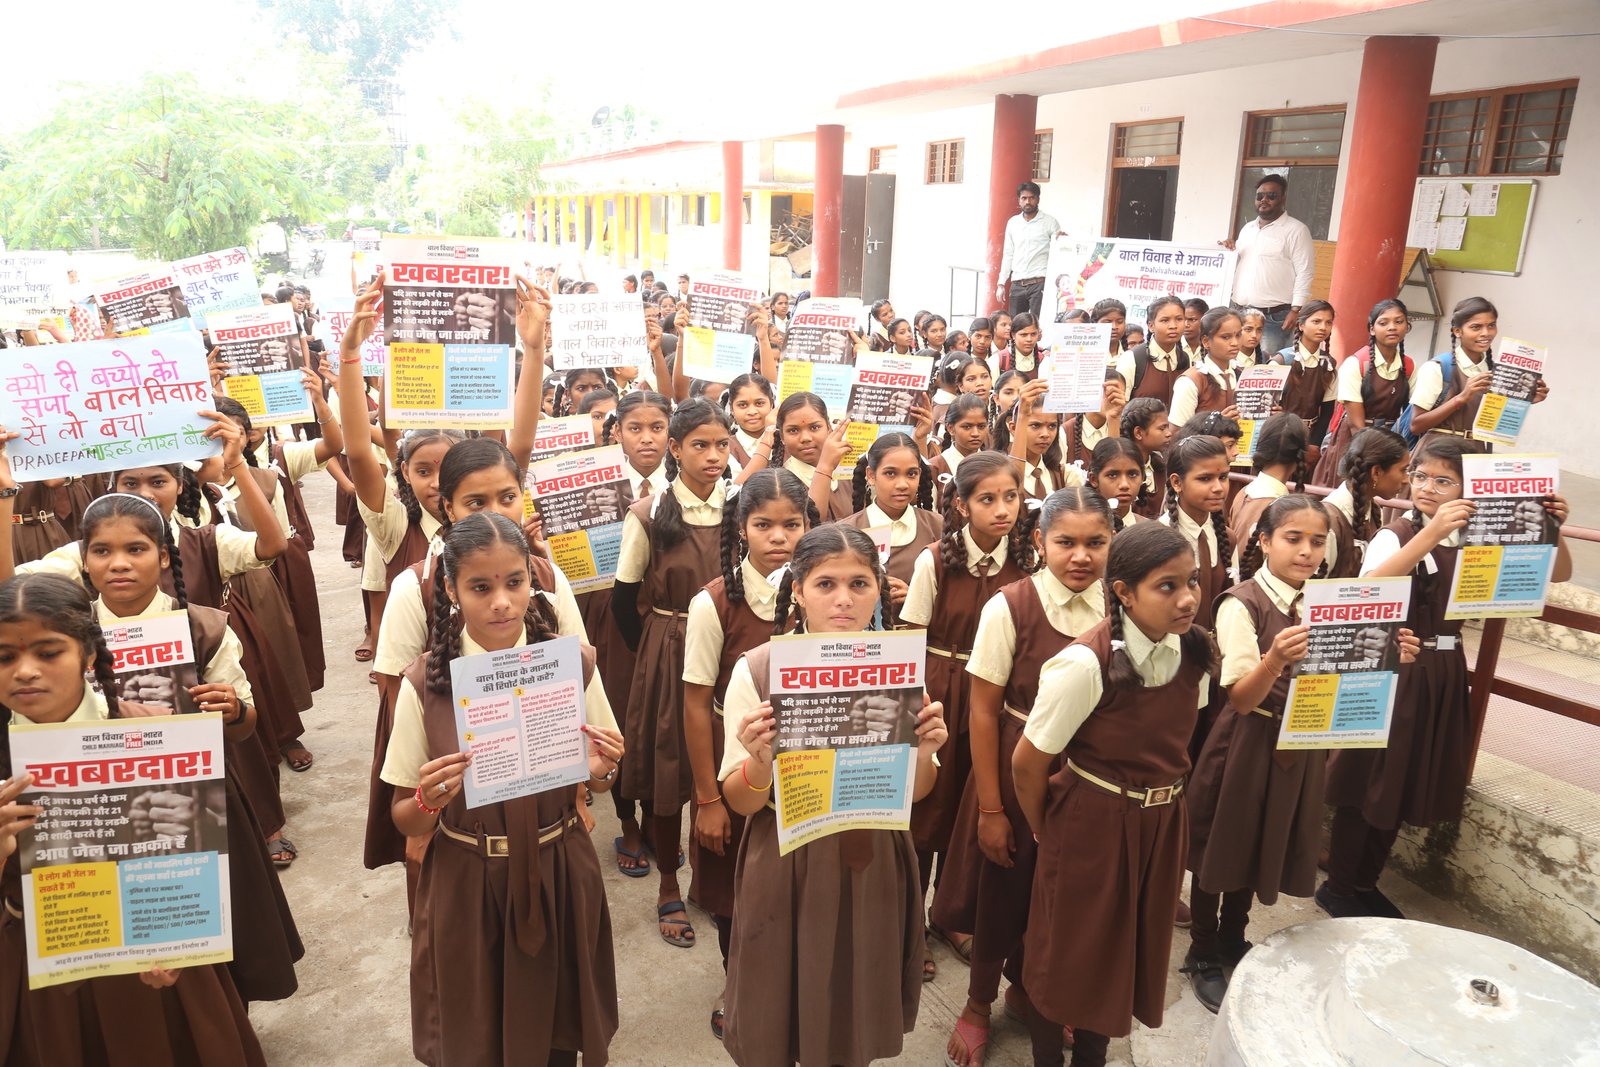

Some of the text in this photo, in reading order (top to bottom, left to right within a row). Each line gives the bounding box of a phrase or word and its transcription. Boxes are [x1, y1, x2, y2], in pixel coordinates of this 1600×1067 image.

[1120, 249, 1224, 268] बाल विवाह से आजादी
[186, 272, 239, 293] बाल विवाह
[392, 263, 509, 285] खबरदार!
[100, 276, 173, 304] खबरदार!
[694, 282, 757, 300] खबरदार!
[1140, 275, 1164, 290] विवाह
[1167, 280, 1185, 296] मुक्त
[793, 314, 856, 328] खबरदार!
[215, 321, 292, 341] खबरदार!
[393, 329, 414, 339] आप
[416, 329, 436, 339] जेल
[439, 329, 452, 339] जा
[587, 335, 616, 349] विवाह
[859, 370, 926, 387] खबरदार!
[13, 377, 207, 418] सजा बाल विवाह
[22, 417, 46, 445] से
[58, 412, 88, 439] लो
[534, 432, 589, 450] बरदार!
[535, 465, 622, 494] खबरदार!
[1471, 478, 1553, 494] खबरदार!
[547, 524, 562, 534] आप
[564, 520, 579, 530] जेल
[580, 518, 590, 527] जा
[1310, 602, 1402, 622] खबरदार!
[476, 659, 559, 683] बाल विवाह के मामलों
[1301, 662, 1317, 672] आप
[1320, 661, 1336, 671] जेल
[1338, 660, 1348, 670] जा
[780, 663, 916, 688] खबरदार!
[483, 682, 494, 693] की
[781, 698, 794, 707] यदि
[796, 698, 808, 706] आप
[820, 697, 829, 705] वर्ष
[838, 696, 850, 704] कम
[792, 708, 802, 716] की
[82, 734, 100, 742] बाल
[102, 732, 124, 741] विवाह
[143, 731, 162, 739] भारत
[98, 741, 124, 749] MARRIAGE
[126, 740, 142, 748] FREE
[144, 739, 163, 747] INDIA
[780, 737, 801, 748] आप
[805, 735, 827, 746] जेल
[830, 734, 846, 745] जा
[26, 750, 212, 788] खबरदार!
[52, 796, 70, 805] आप
[72, 795, 83, 804] 18
[85, 795, 98, 804] वर्ष
[99, 794, 108, 803] से
[110, 794, 127, 803] कम
[50, 808, 63, 817] की
[93, 806, 109, 815] और
[111, 806, 121, 814] 21
[34, 820, 49, 830] वर्ष
[51, 820, 59, 829] से
[61, 819, 77, 828] कम
[79, 818, 92, 827] उम्र
[94, 818, 103, 826] के
[35, 832, 49, 842] की
[51, 830, 72, 841] शादी
[74, 829, 96, 839] करते
[105, 828, 115, 837] तो
[36, 846, 68, 861] आप
[73, 843, 104, 858] जेल
[109, 841, 129, 855] जा
